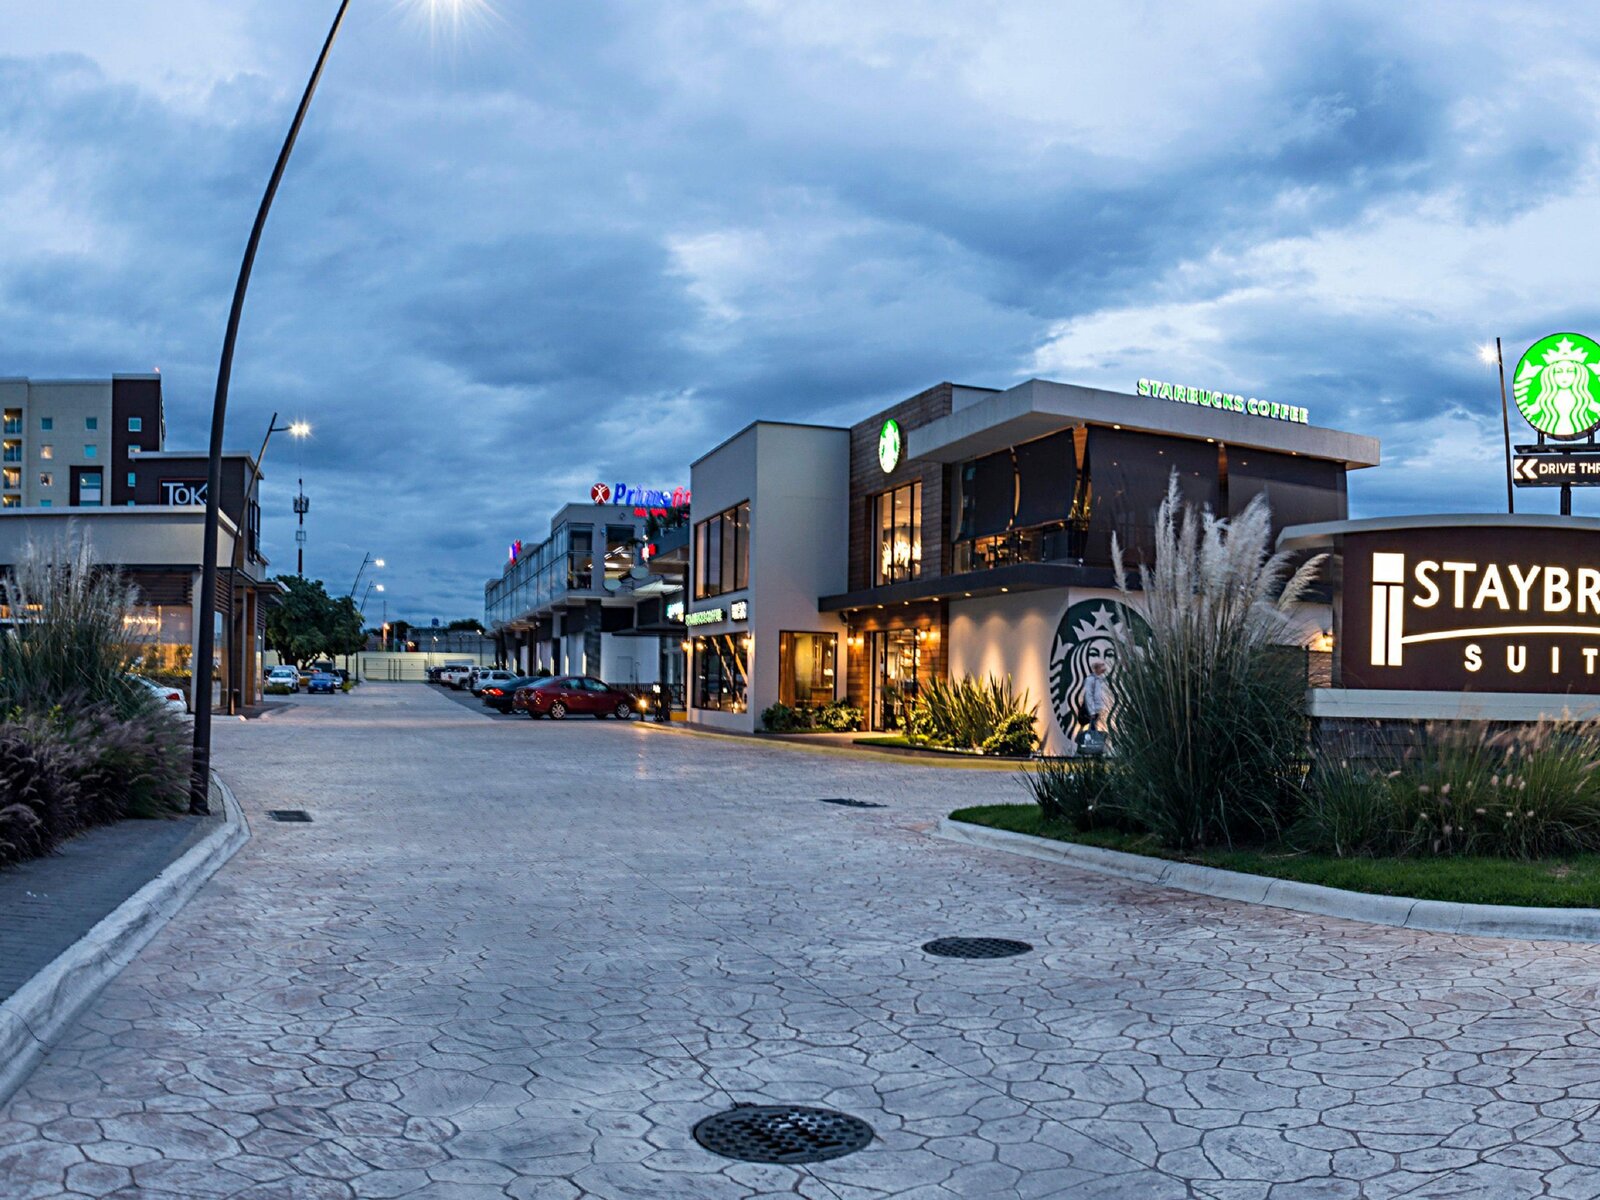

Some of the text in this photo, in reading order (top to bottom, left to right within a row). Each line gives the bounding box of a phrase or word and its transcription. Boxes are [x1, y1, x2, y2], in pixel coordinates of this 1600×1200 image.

[1138, 377, 1309, 425] STARBUCKS COFFEE
[1539, 462, 1576, 474] DRIVE
[1464, 644, 1598, 674] SUIT
